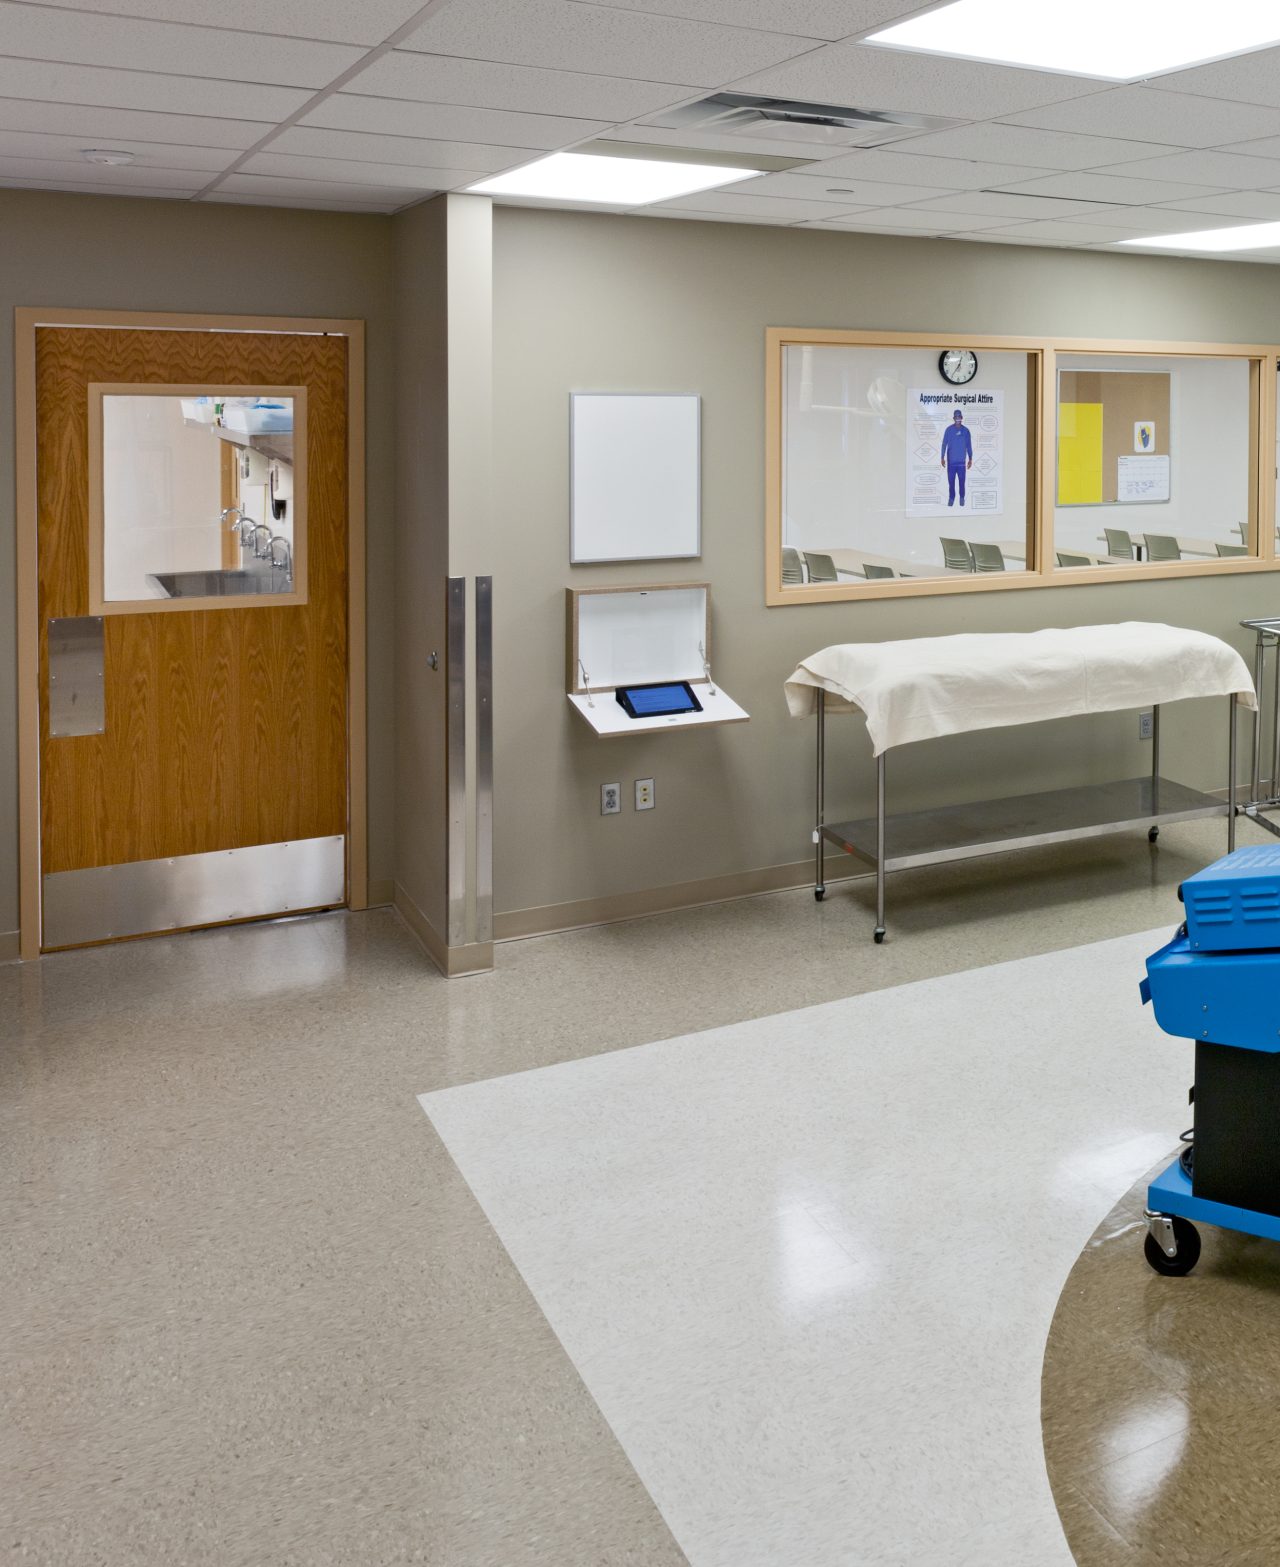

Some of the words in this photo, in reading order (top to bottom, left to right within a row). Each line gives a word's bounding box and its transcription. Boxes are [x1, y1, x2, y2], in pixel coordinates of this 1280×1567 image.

[919, 393, 953, 405] Appropriate
[954, 393, 976, 405] Surgical
[978, 394, 993, 403] Attire
